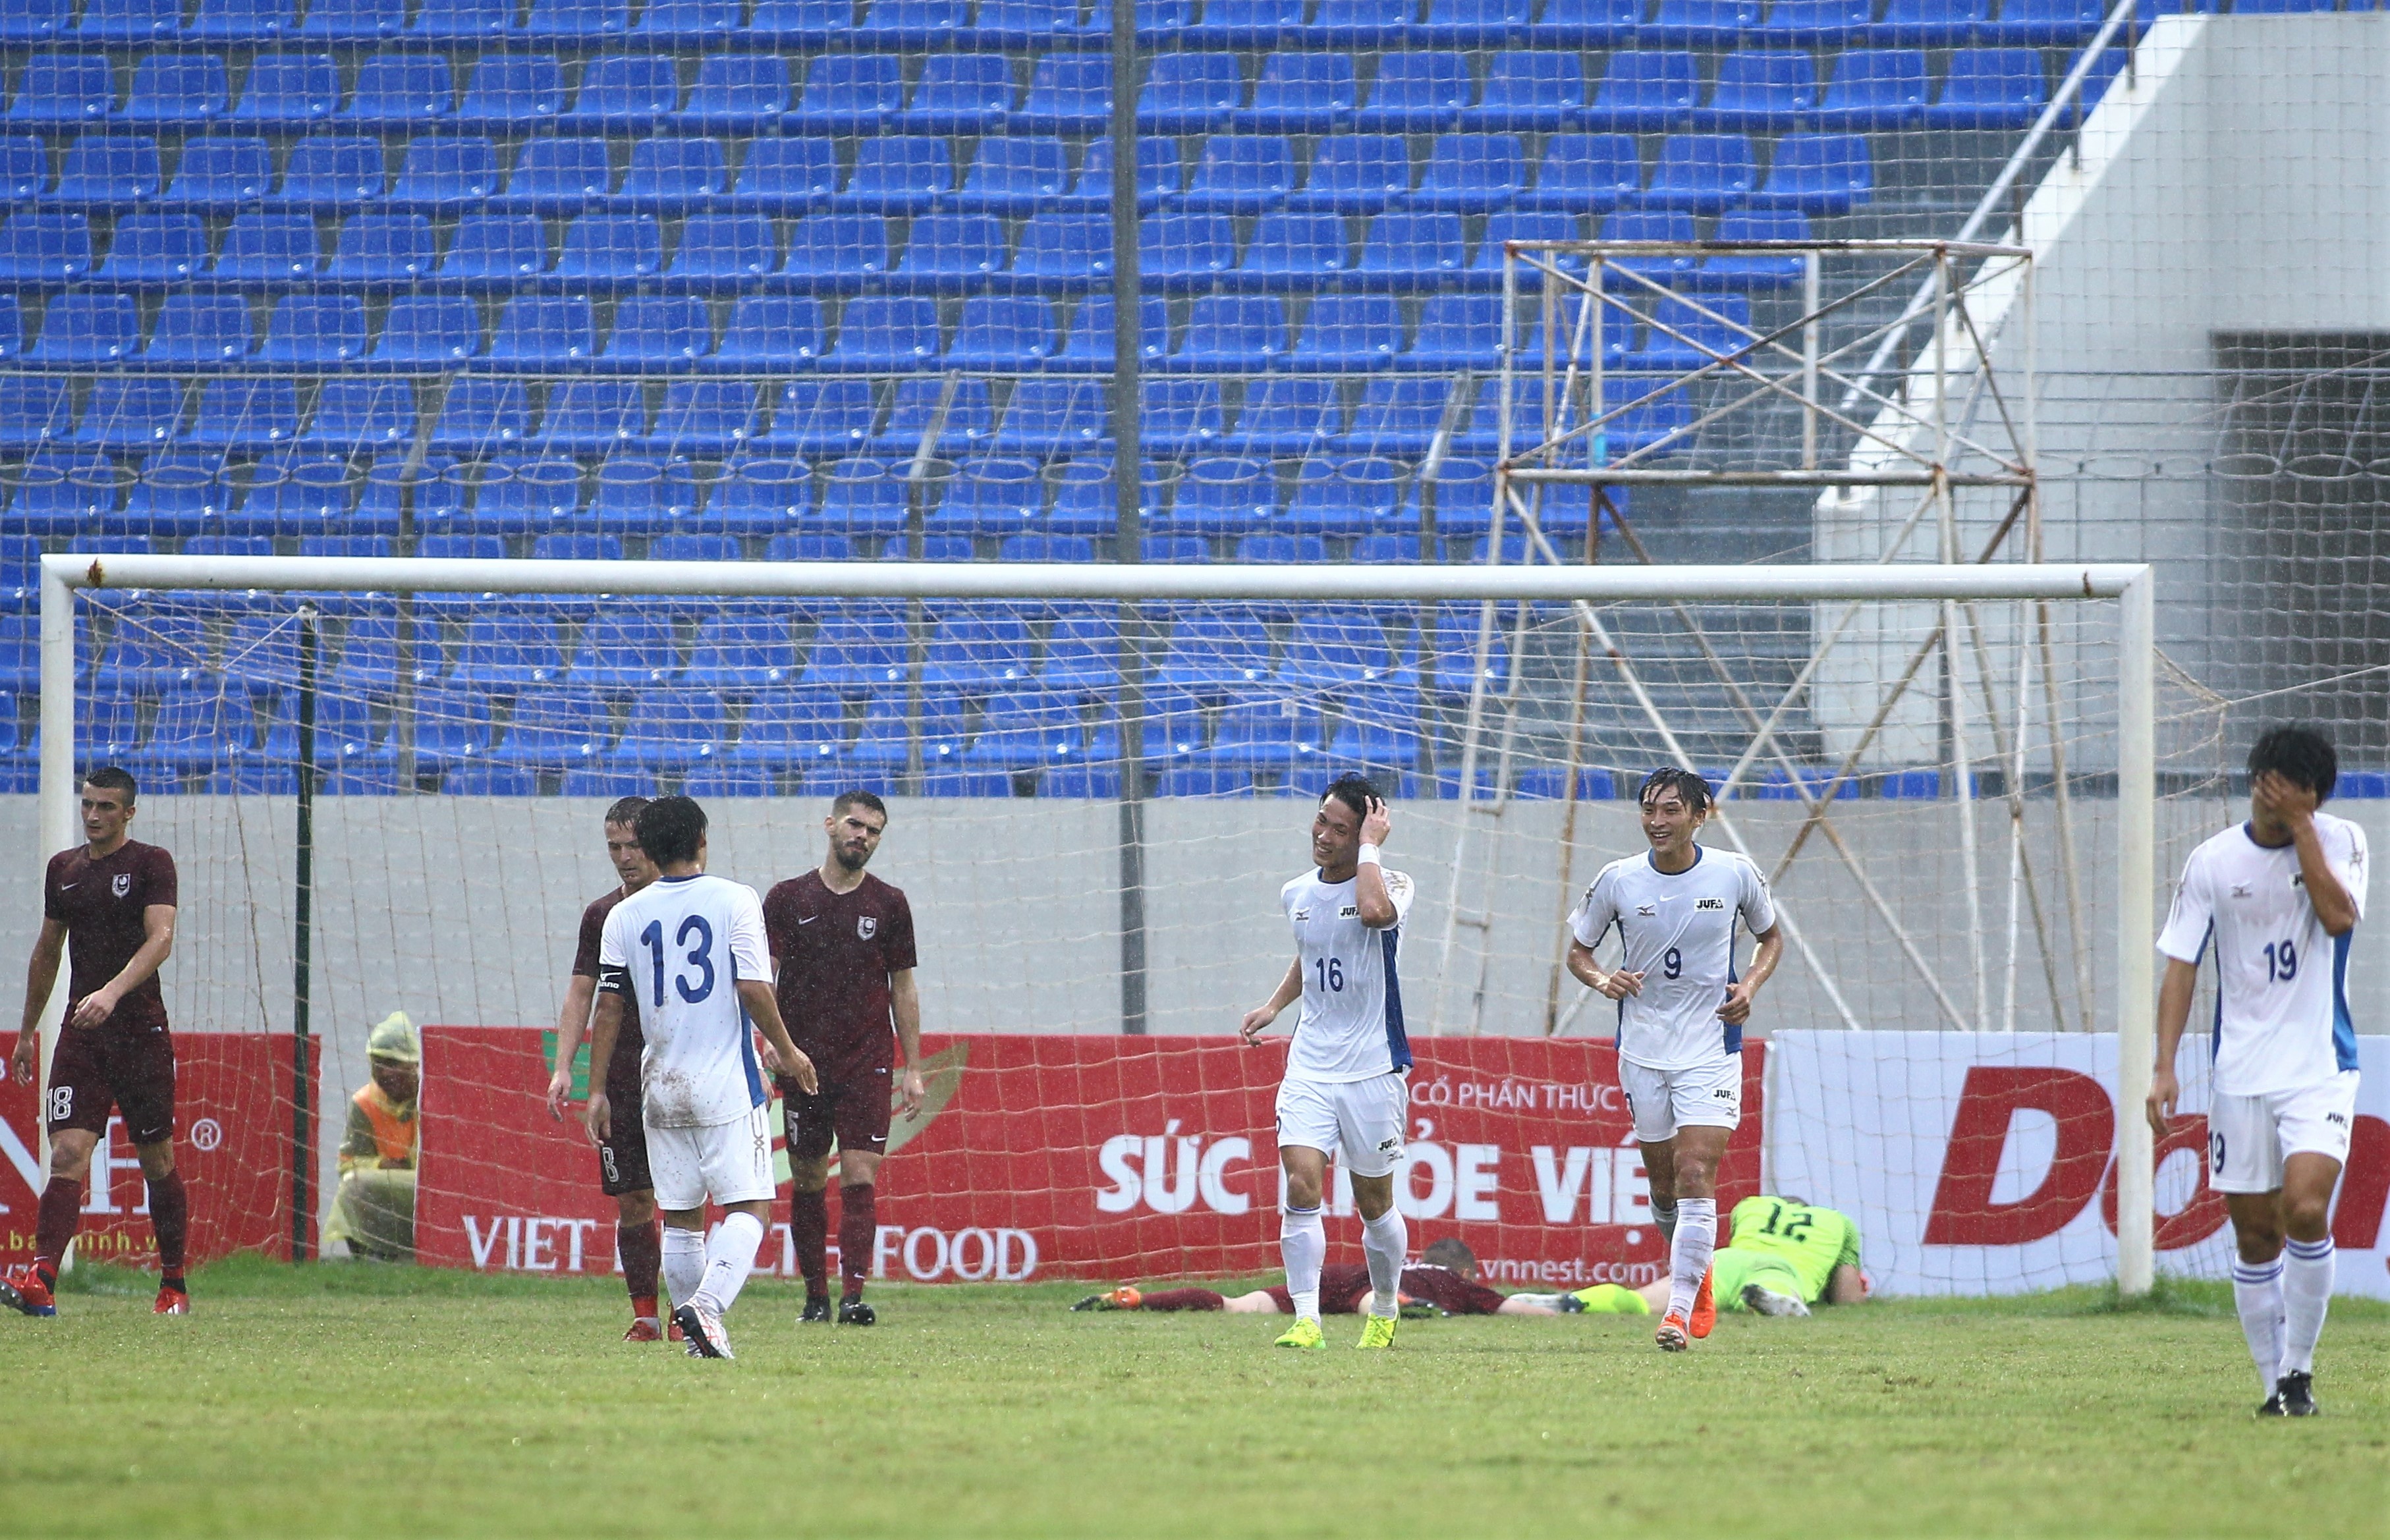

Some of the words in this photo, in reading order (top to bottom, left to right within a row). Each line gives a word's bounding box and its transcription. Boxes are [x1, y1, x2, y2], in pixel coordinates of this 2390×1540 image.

[641, 914, 715, 1007] 13
[1316, 957, 1344, 992] 16
[1663, 947, 1681, 979] 9
[2264, 939, 2297, 983] 19
[1097, 1120, 1250, 1215] SỨC
[1759, 1203, 1813, 1244] 12
[462, 1215, 596, 1271] VIET
[873, 1224, 1038, 1282] FOOD
